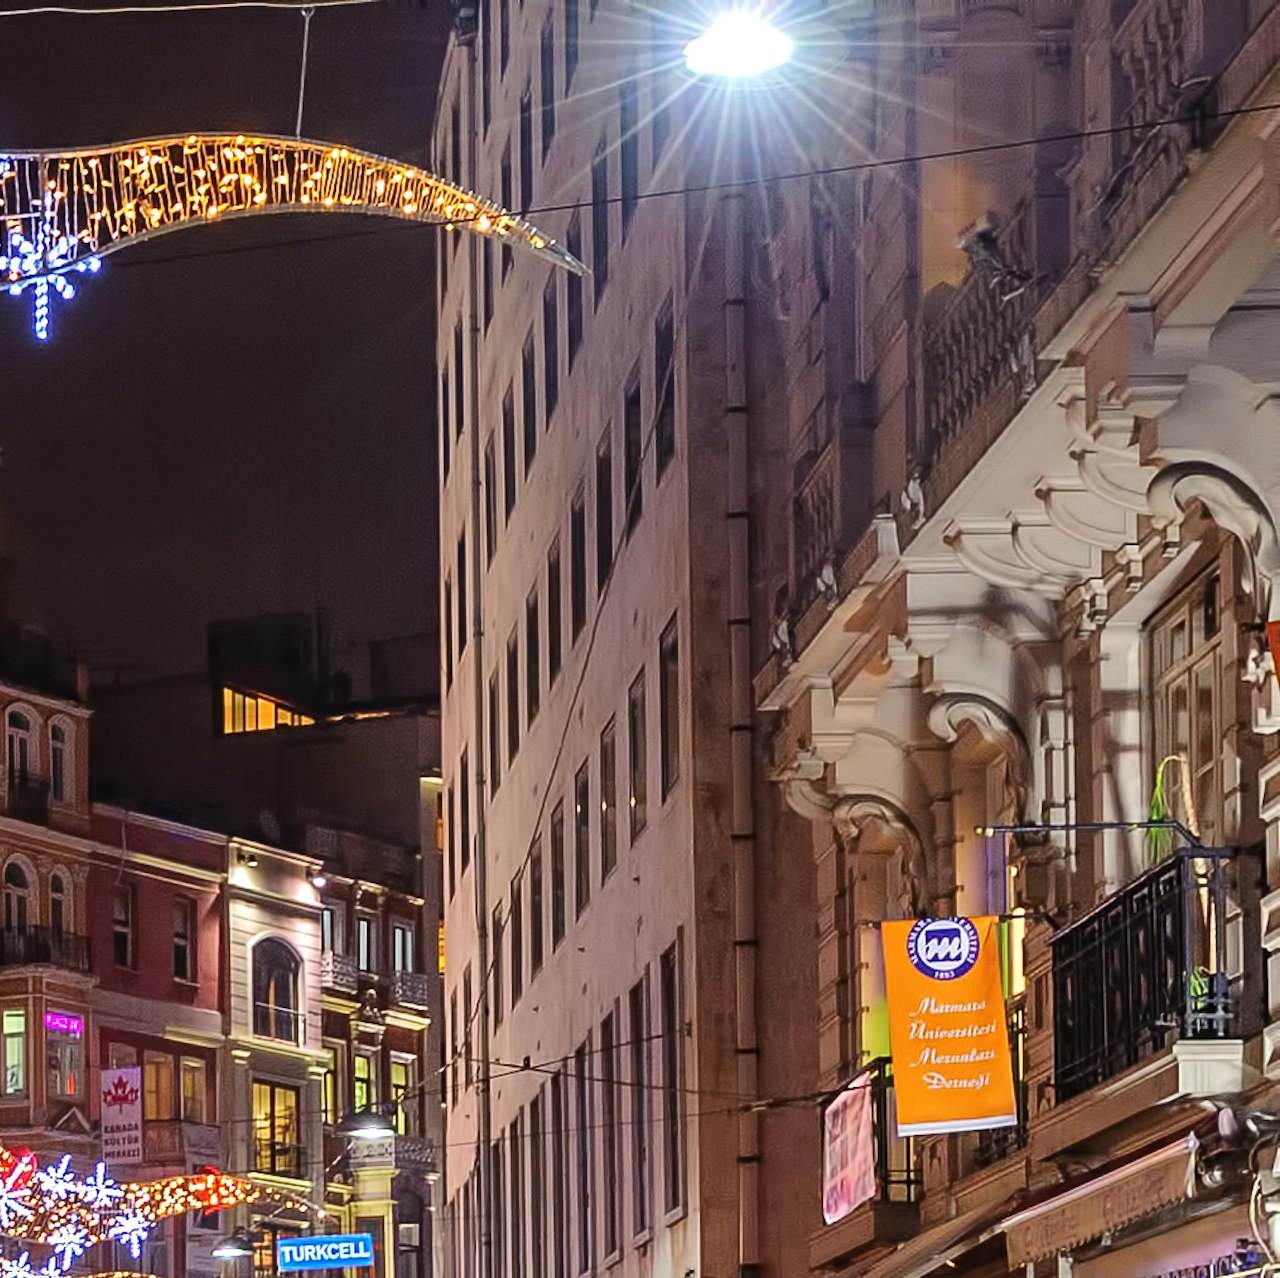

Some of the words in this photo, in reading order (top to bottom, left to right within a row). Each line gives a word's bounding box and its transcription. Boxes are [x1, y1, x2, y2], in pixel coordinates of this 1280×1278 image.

[909, 997, 986, 1017] Marmara
[909, 1020, 996, 1040] Üniversitesi
[909, 1048, 995, 1067] Mezunları
[923, 1071, 990, 1090] Derneği
[280, 1241, 371, 1263] TURKCELL
